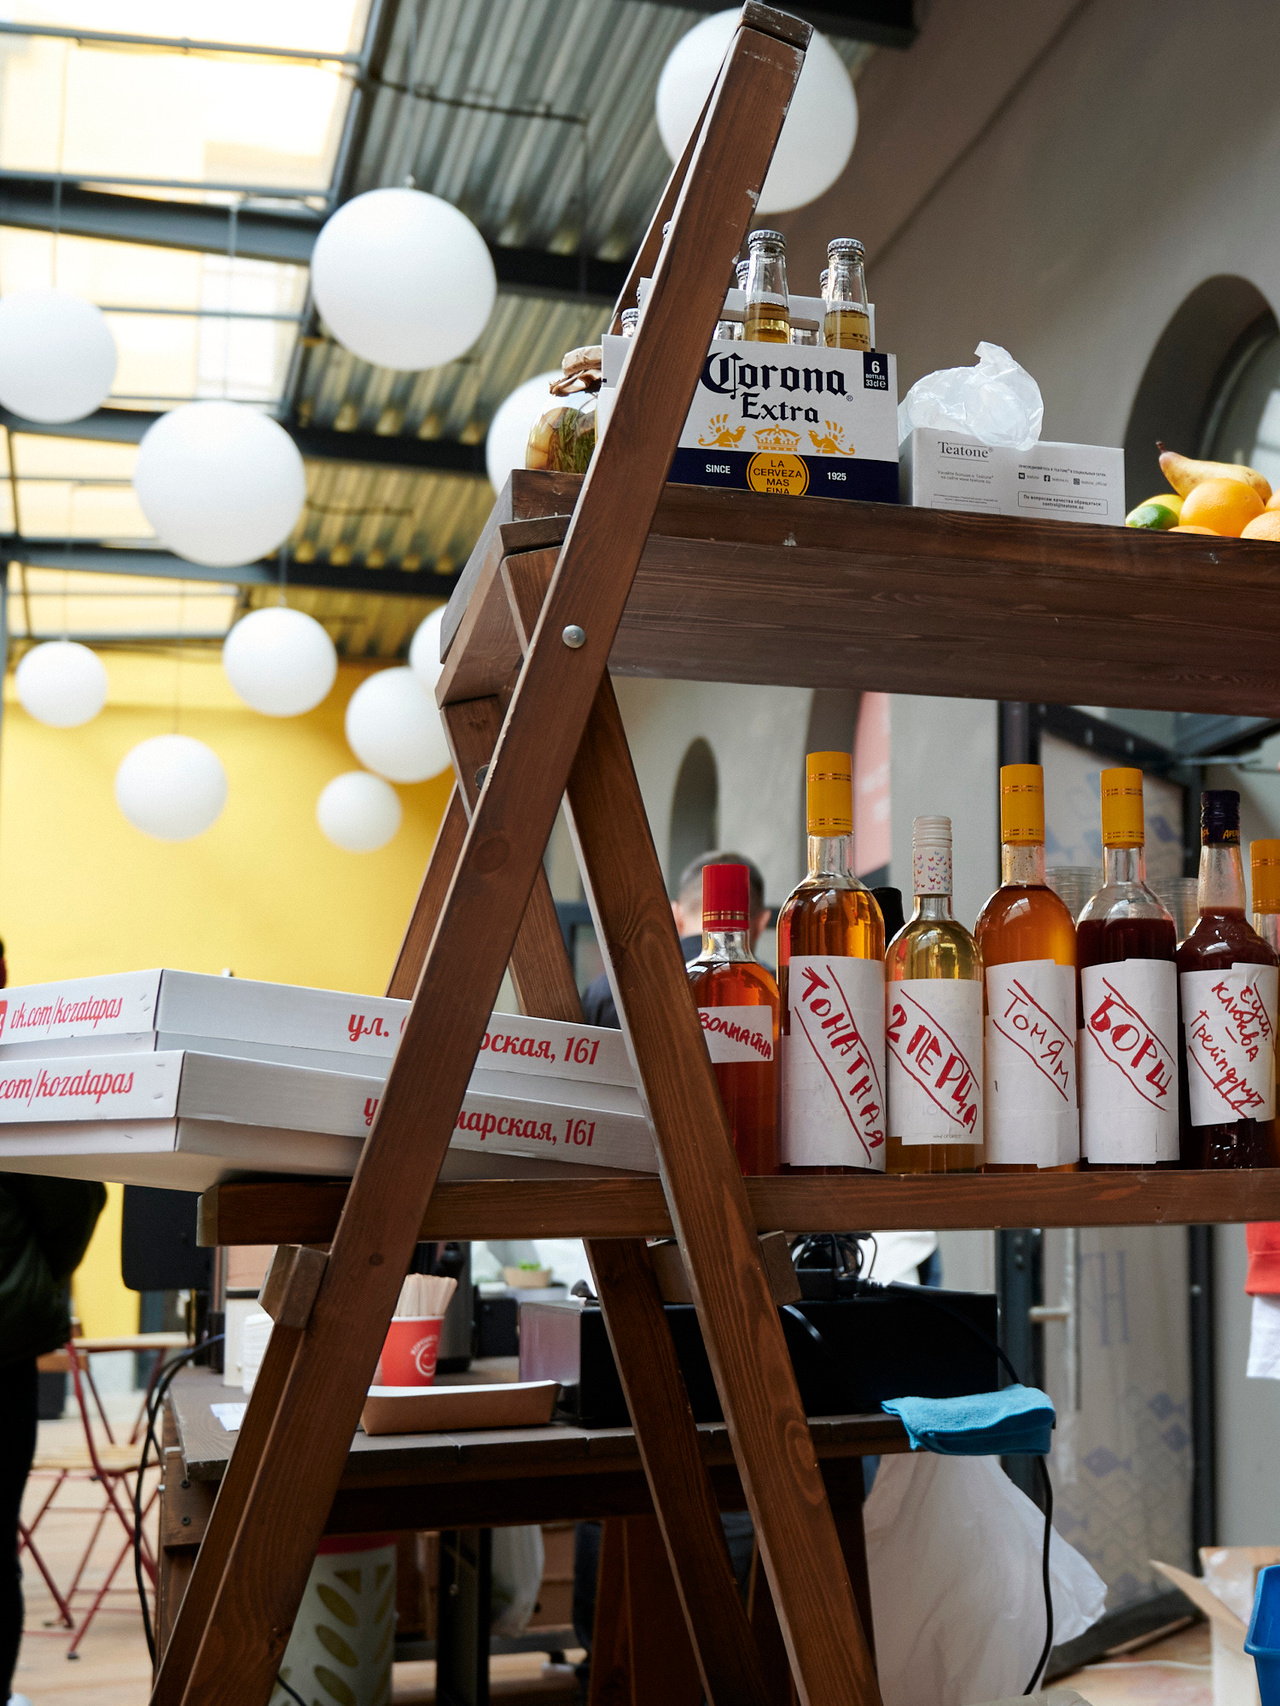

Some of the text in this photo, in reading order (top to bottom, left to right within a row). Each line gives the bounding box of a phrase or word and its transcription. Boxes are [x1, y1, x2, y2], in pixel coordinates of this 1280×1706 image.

[871, 360, 880, 374] 6
[699, 352, 848, 400] Corona
[866, 373, 885, 381] BOTTLES
[740, 392, 820, 424] Extra
[705, 464, 731, 474] SINCE
[770, 460, 785, 468] LA
[753, 468, 802, 478] CERVEZA
[827, 471, 847, 481] 1925
[766, 478, 790, 487] MAS
[10, 995, 123, 1034] vk.com/kozatapas
[886, 1003, 908, 1044] 2
[347, 1013, 389, 1042] ул.
[563, 1036, 601, 1065] 161
[564, 1118, 596, 1147] 161
